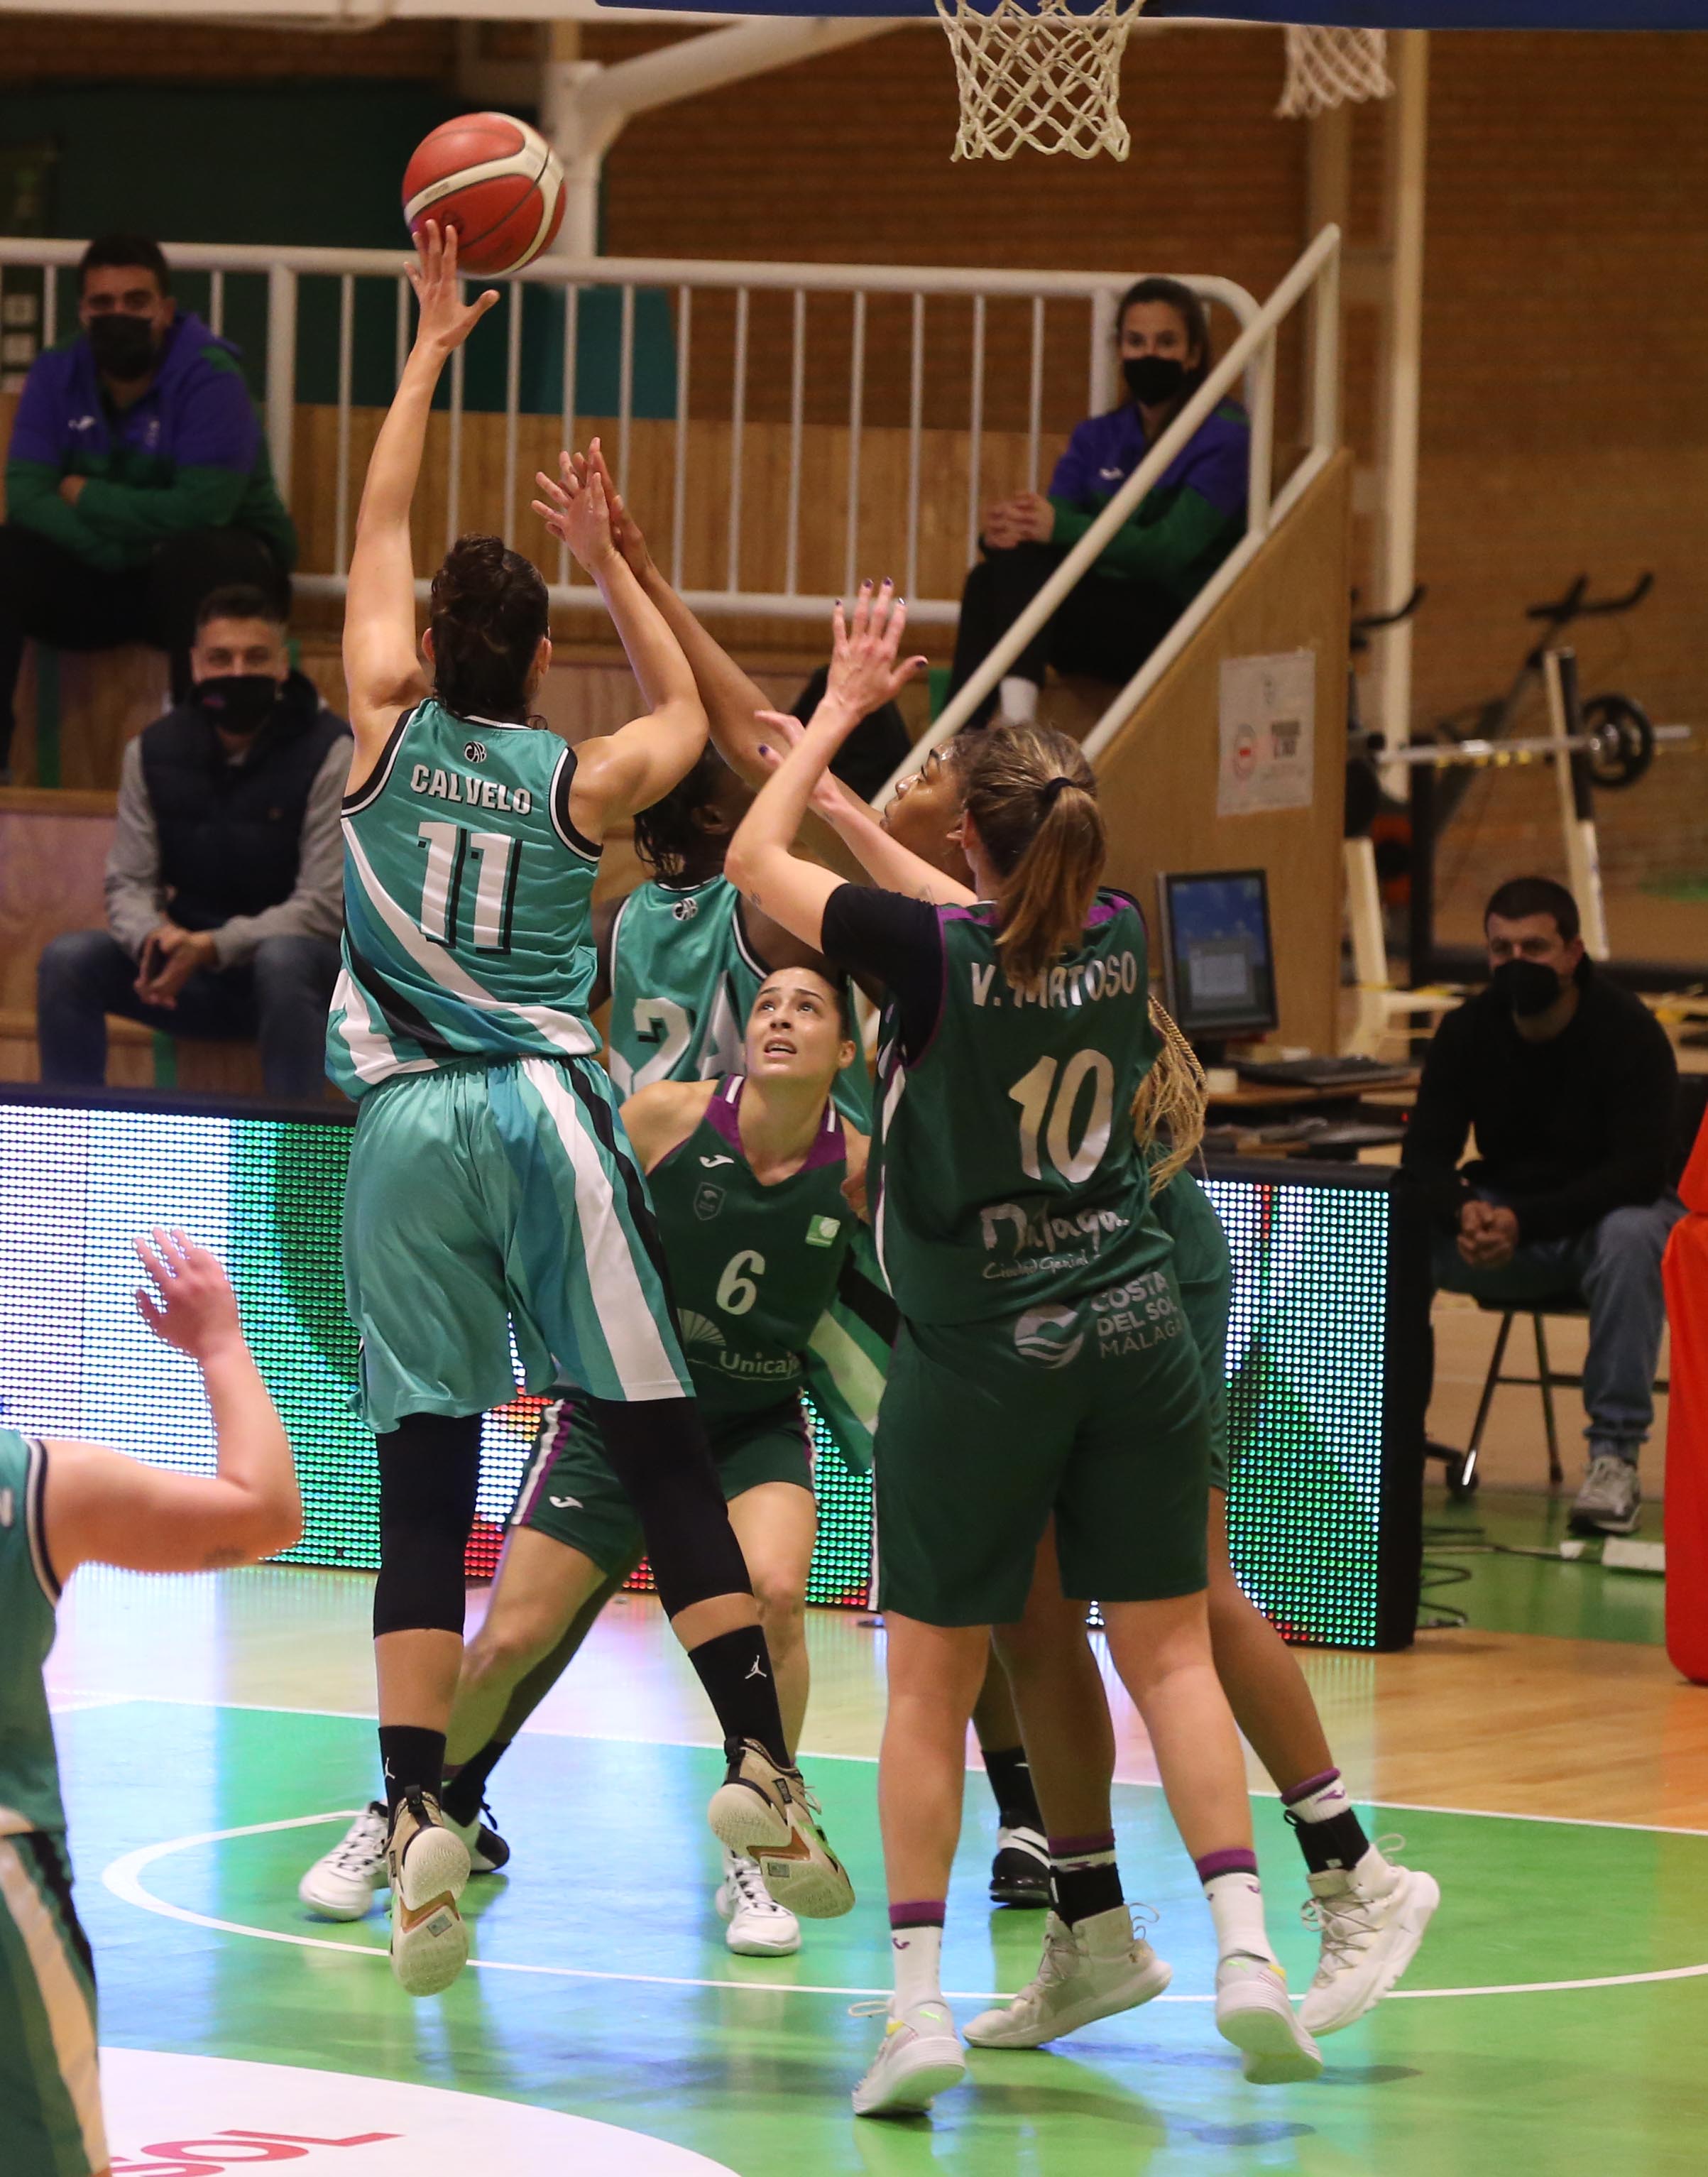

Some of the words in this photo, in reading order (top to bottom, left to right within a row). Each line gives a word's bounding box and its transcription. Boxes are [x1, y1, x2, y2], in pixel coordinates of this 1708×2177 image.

[410, 763, 532, 815] CALVELO
[417, 821, 523, 955] 11
[970, 961, 1002, 1008] V.
[1009, 1049, 1113, 1184] 10
[716, 1249, 766, 1316] 6
[1090, 1271, 1170, 1312] COSTA
[1097, 1311, 1146, 1337] DEL
[1144, 1296, 1178, 1321] SOL
[719, 1350, 800, 1378] Unicaj
